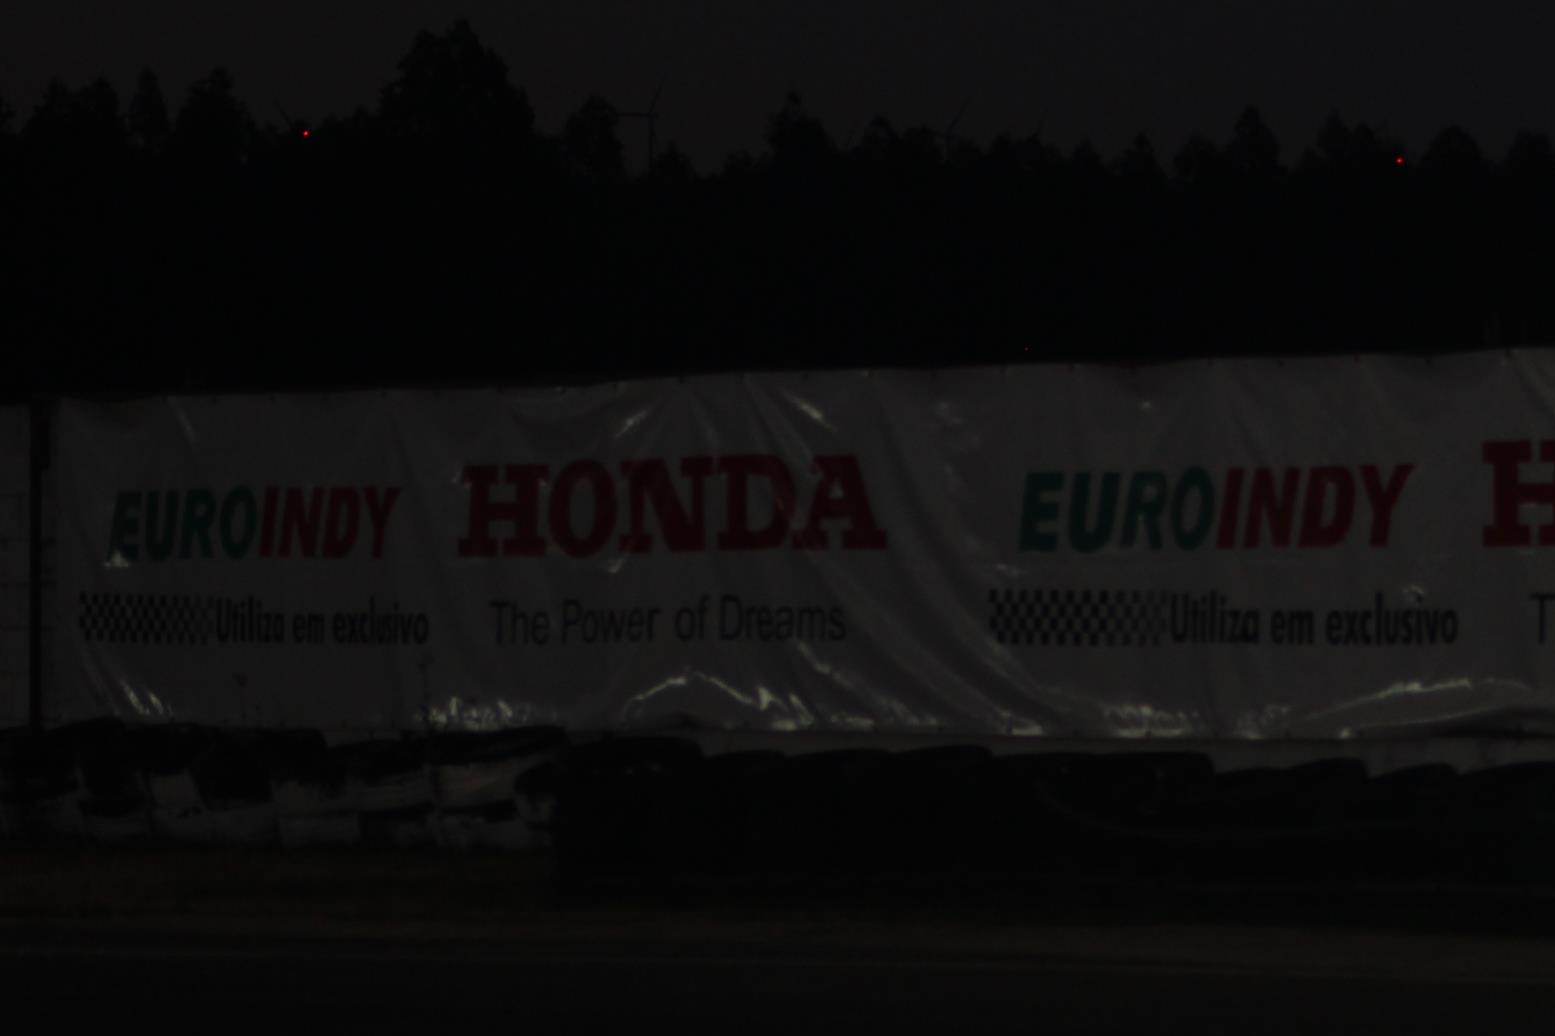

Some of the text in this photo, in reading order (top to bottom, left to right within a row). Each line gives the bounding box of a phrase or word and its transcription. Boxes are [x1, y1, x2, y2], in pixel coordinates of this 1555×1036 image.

[108, 485, 401, 560] EUROINDY
[459, 454, 887, 558] HONDA
[1019, 464, 1414, 552] EUROINDY
[215, 596, 429, 644] Utiliza em exclusivo
[491, 594, 847, 645] The Power of Dreams
[1169, 590, 1457, 645] Utiliza em exclusivo
